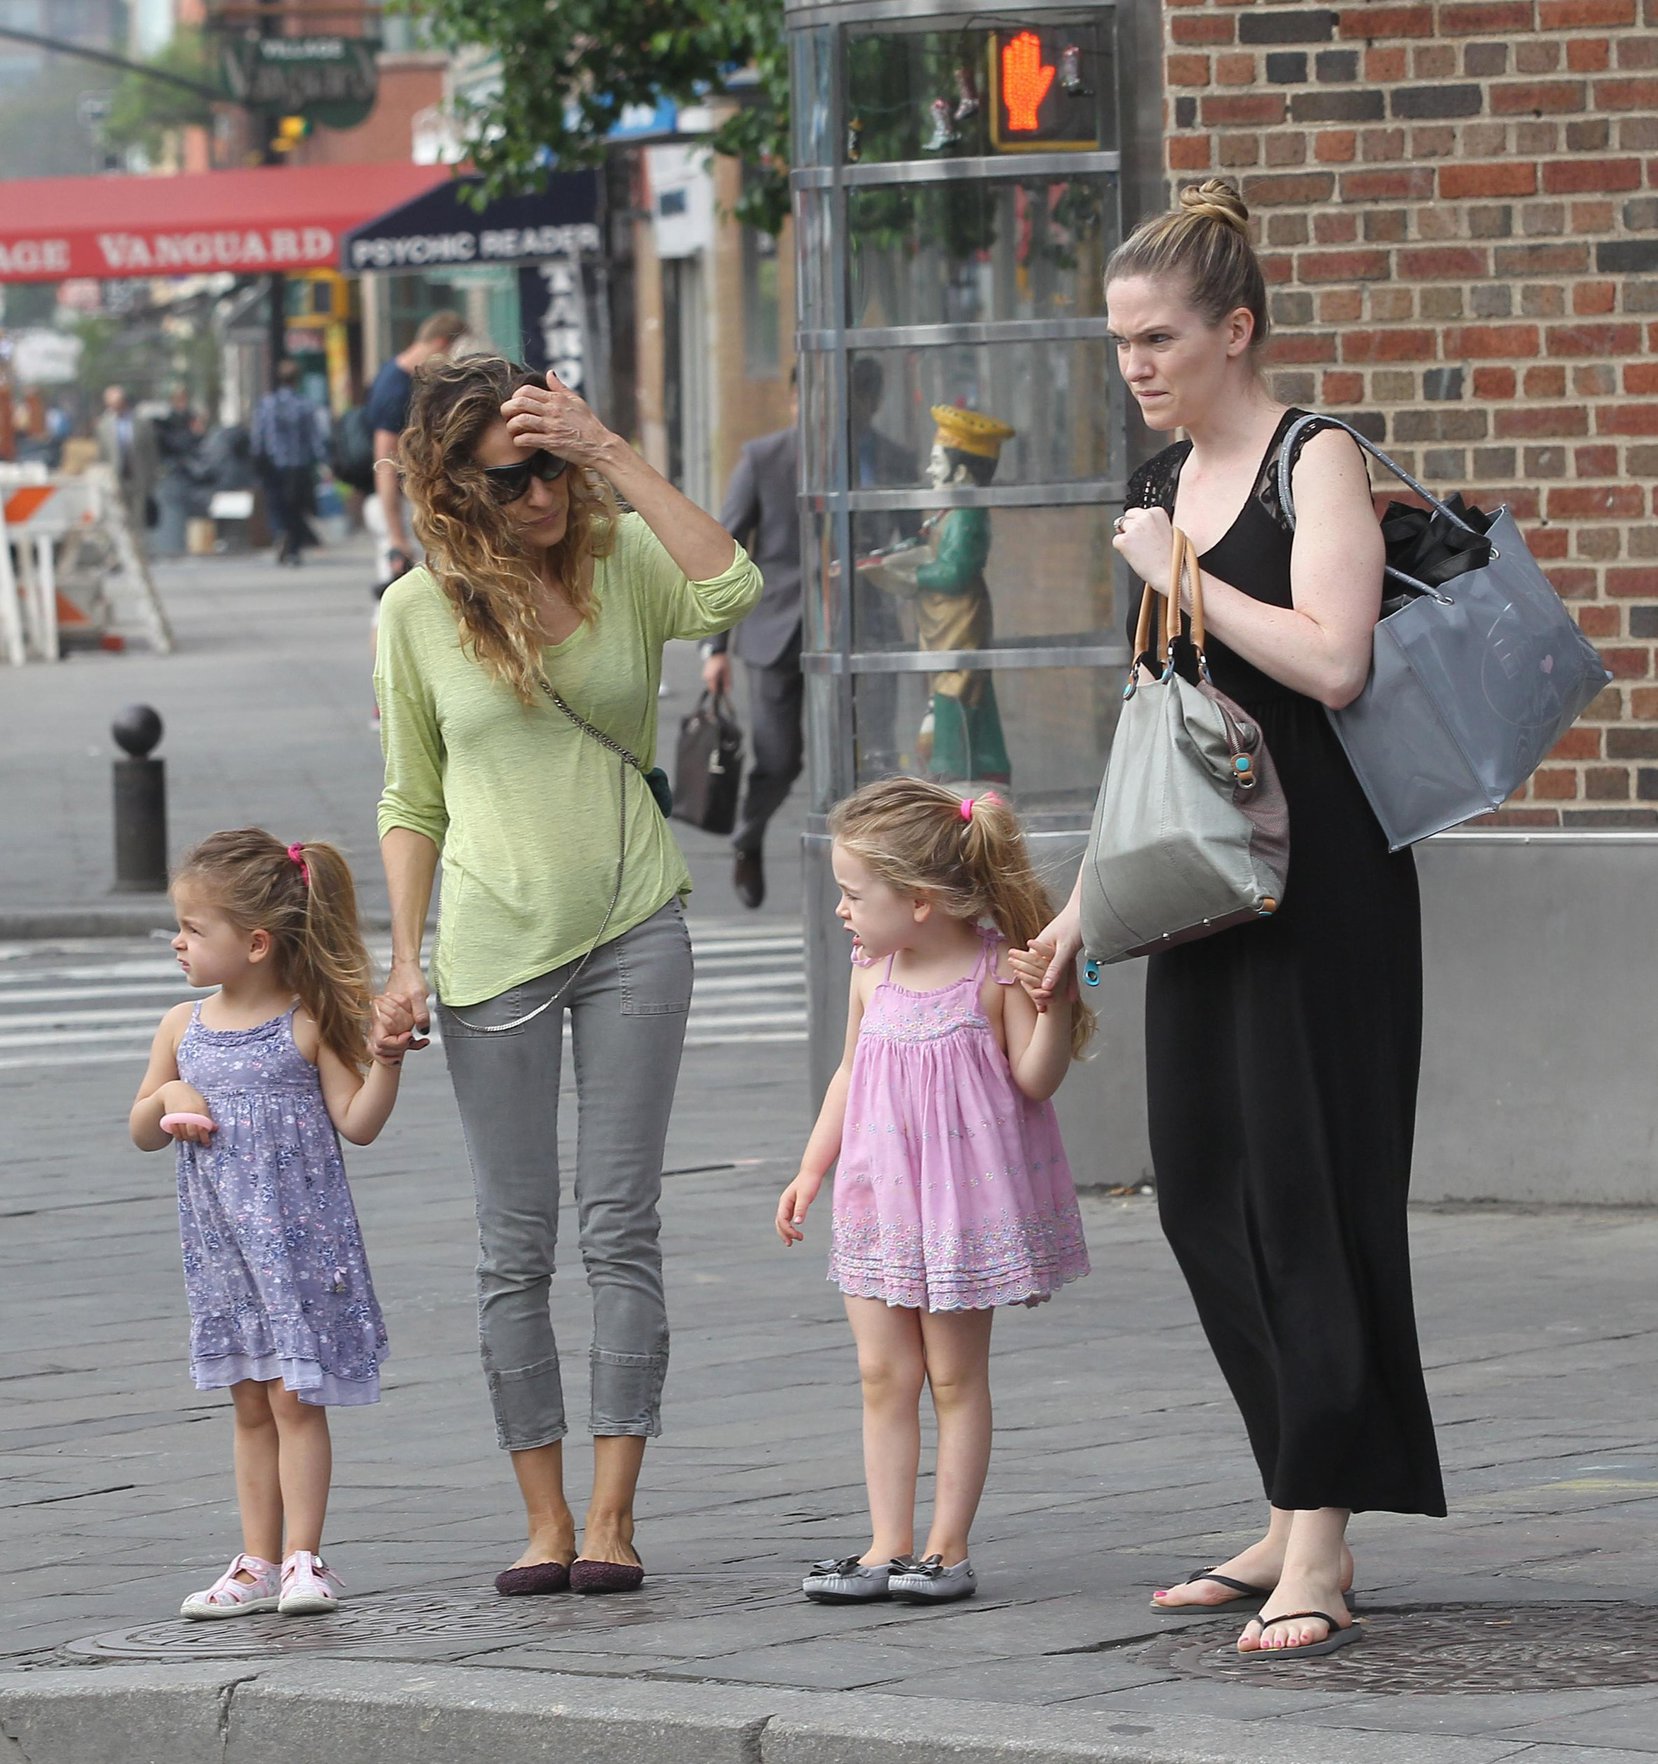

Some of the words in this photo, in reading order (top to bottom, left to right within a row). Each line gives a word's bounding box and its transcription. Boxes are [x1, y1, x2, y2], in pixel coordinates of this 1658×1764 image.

[98, 228, 332, 267] VANGUARD
[353, 232, 478, 266] PSYCHIC
[481, 224, 598, 256] READER
